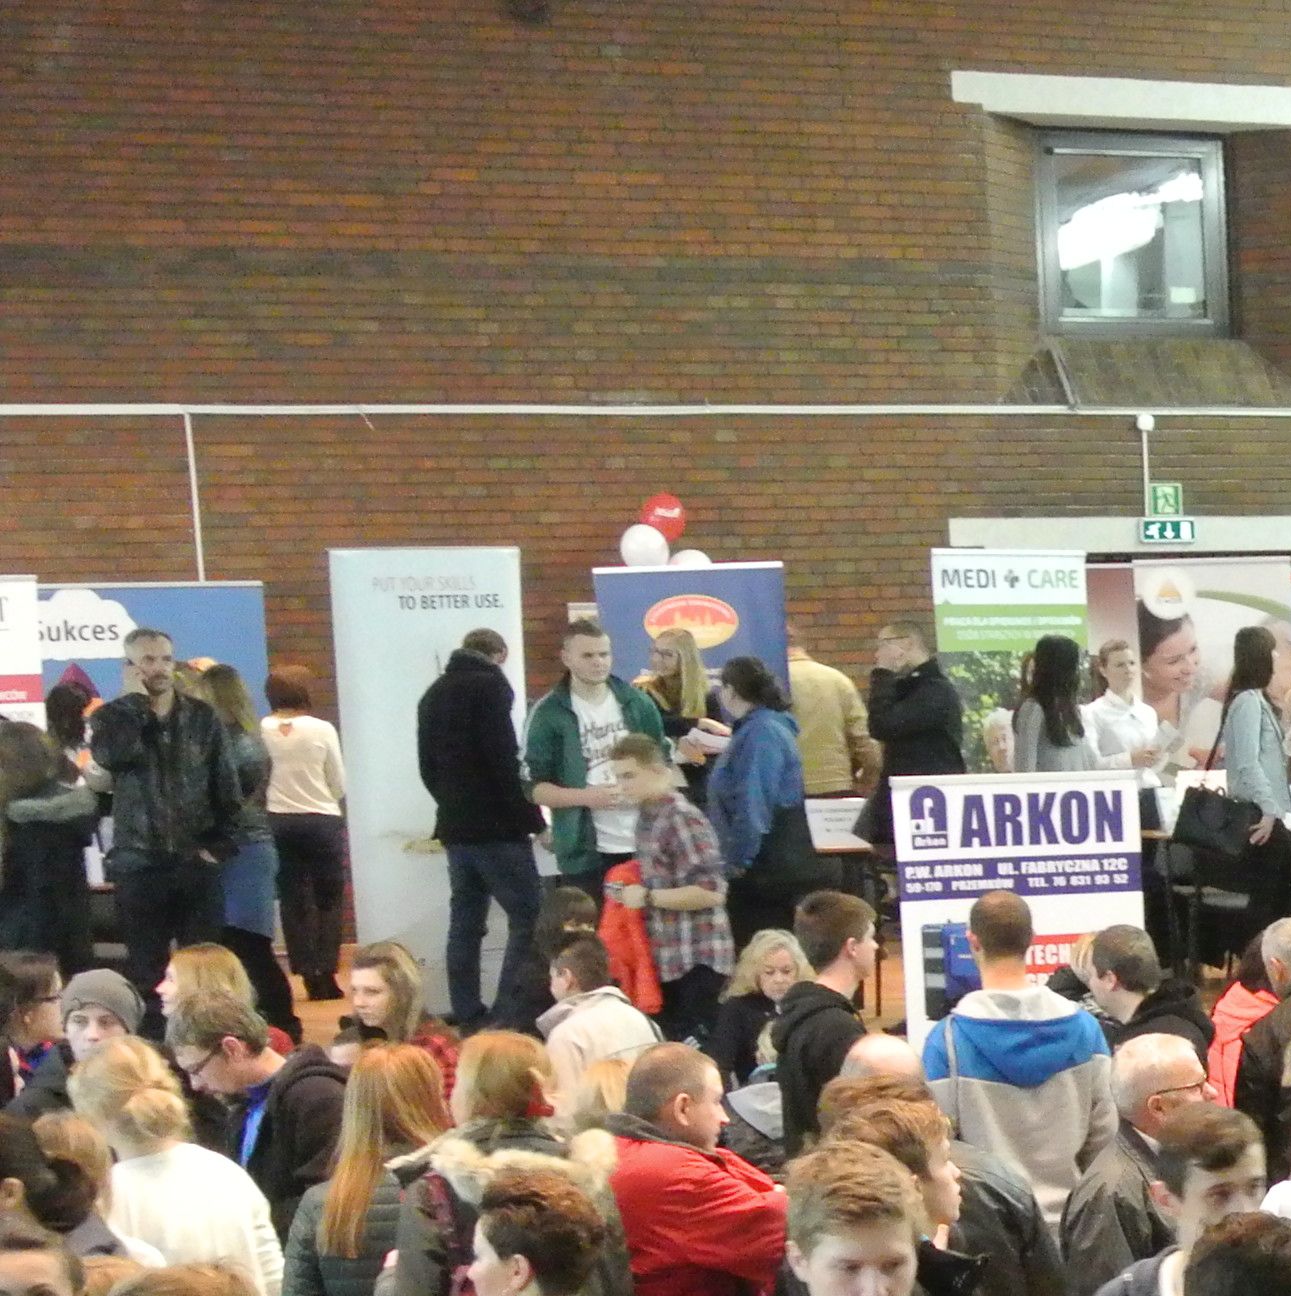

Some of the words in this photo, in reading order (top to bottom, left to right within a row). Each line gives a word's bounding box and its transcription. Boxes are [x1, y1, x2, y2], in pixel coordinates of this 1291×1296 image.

[941, 569, 996, 589] MEDI
[1027, 569, 1080, 589] CARE
[399, 595, 416, 610] TO
[420, 594, 470, 610] BETTER
[475, 594, 504, 609] USE.
[960, 790, 1124, 848] ARKON
[934, 862, 983, 878] ARKON
[997, 862, 1019, 875] UL.
[1021, 858, 1101, 874] FABRYCZNA
[1101, 857, 1128, 871] 12C
[1027, 876, 1049, 888] TEL.
